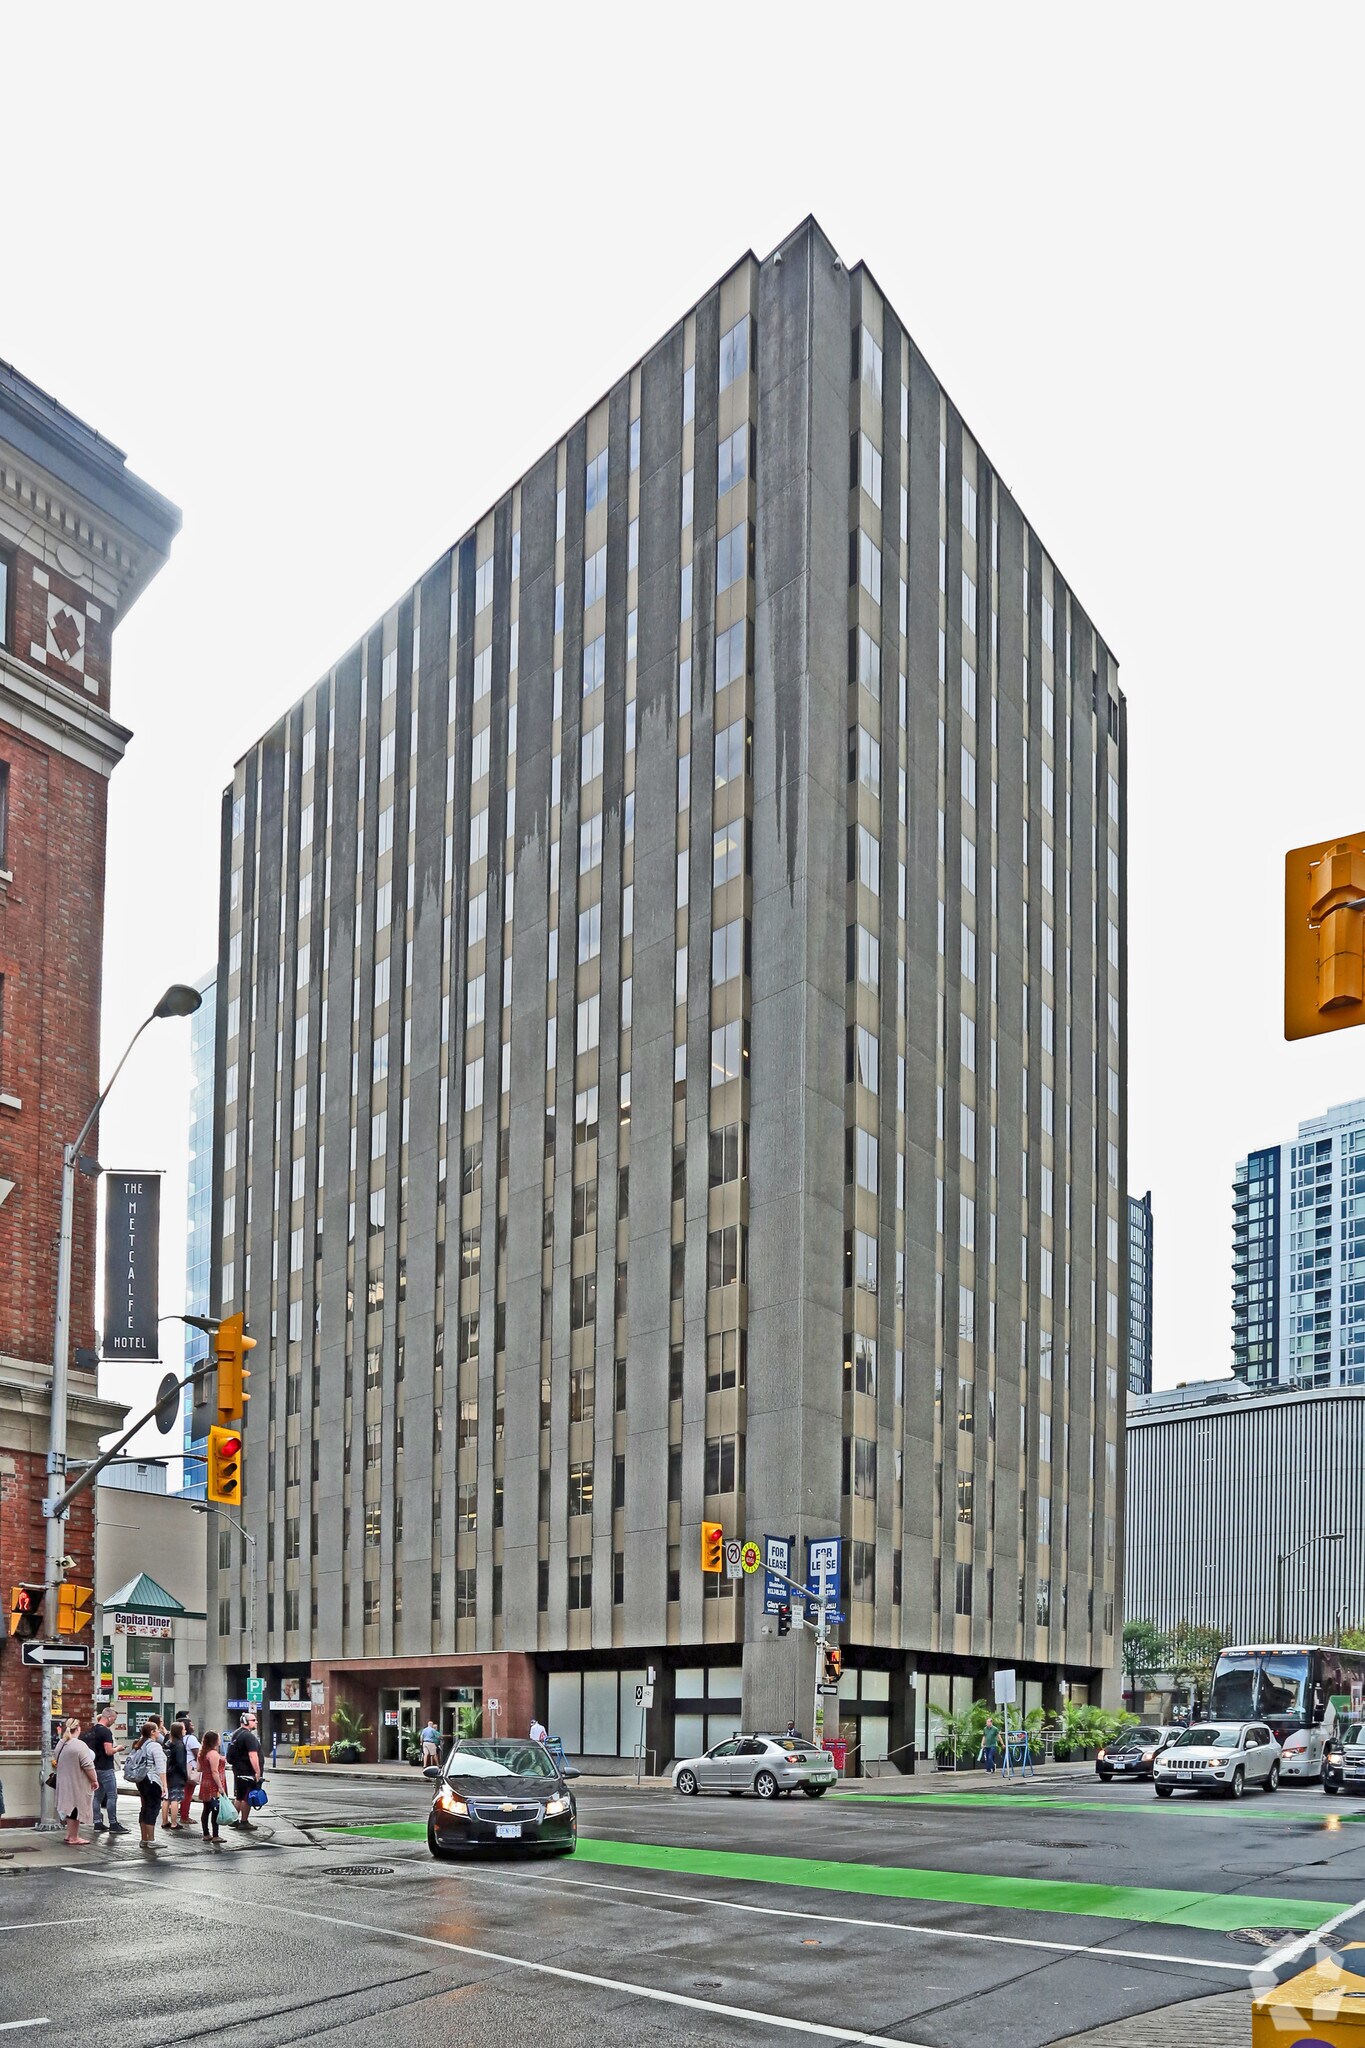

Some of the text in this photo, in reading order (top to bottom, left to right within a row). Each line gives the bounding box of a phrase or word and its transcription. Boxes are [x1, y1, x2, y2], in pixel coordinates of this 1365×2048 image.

[124, 1183, 143, 1194] THE
[127, 1201, 137, 1329] METCALFE
[114, 1337, 147, 1349] HOTEL
[771, 1546, 785, 1558] FOR
[768, 1558, 787, 1570] LEASE
[811, 1560, 836, 1571] LESE
[115, 1613, 171, 1627] Capital Diner
[250, 1680, 260, 1692] P
